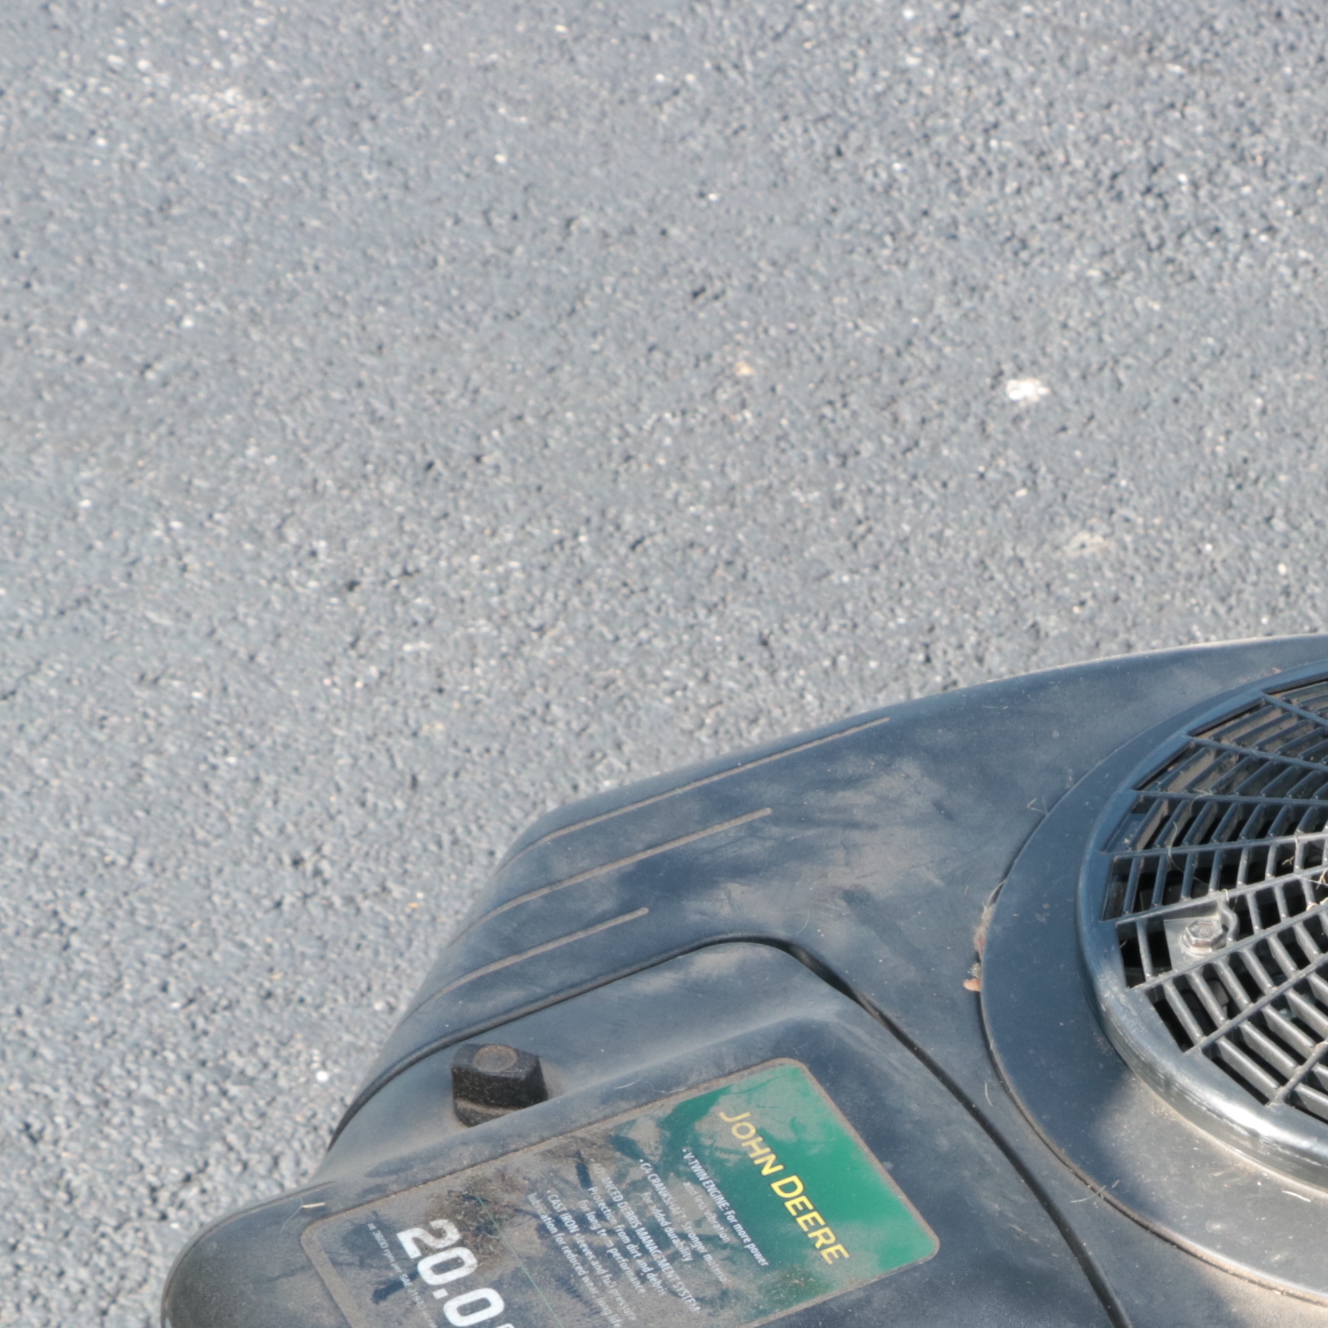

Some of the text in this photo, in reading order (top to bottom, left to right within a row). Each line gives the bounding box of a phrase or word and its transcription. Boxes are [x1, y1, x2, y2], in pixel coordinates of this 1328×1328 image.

[716, 1104, 855, 1266] JOHN DEERE
[525, 1192, 561, 1233] lubrication
[576, 1199, 591, 1212] for
[581, 1211, 603, 1231] long
[681, 1180, 733, 1243] and less vibration
[366, 1222, 376, 1230] at
[370, 1229, 390, 1249] 3600
[545, 1193, 567, 1213] CAST
[558, 1211, 581, 1233] IRON
[570, 1231, 599, 1260] sleeves
[589, 1258, 609, 1275] and
[552, 1232, 569, 1245] for
[639, 1192, 695, 1263] for added durability
[676, 1221, 709, 1255] Stronger
[700, 1179, 731, 1211] ENGINE:
[722, 1210, 739, 1223] For
[731, 1223, 752, 1243] more
[743, 1242, 770, 1268] power
[381, 1248, 396, 1263] rpm
[586, 1186, 669, 1296] Protection from dirt and debris
[615, 1200, 642, 1228] DEBRIS
[633, 1227, 680, 1282] MANAGEMENT
[390, 1261, 404, 1274] per
[559, 1244, 590, 1276] reduced
[605, 1246, 648, 1295] performance
[397, 1273, 413, 1287] SAE
[606, 1314, 624, 1328] life
